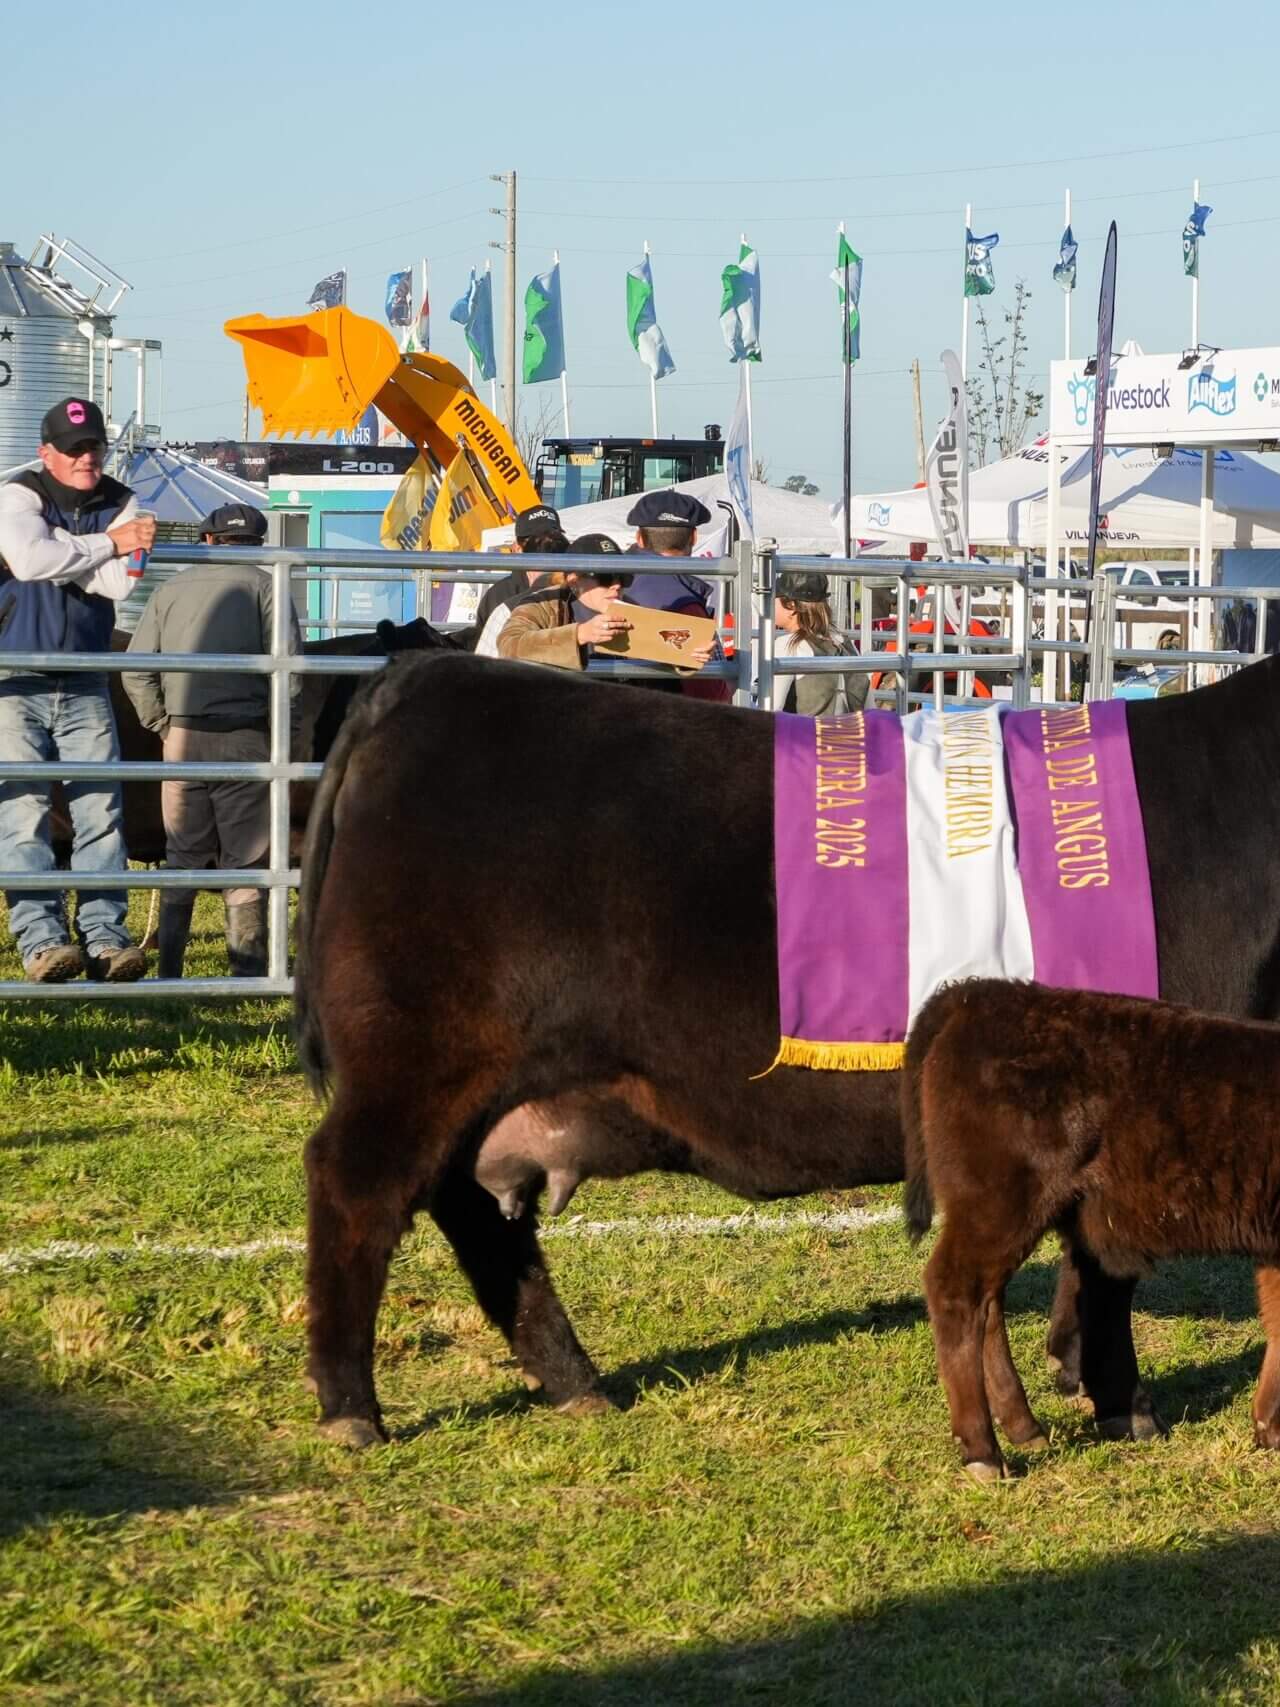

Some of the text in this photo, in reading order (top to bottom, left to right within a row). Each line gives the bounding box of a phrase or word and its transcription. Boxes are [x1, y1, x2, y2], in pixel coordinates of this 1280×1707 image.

[1104, 379, 1170, 409] ivestock
[454, 398, 521, 485] MICHIGAN
[322, 459, 395, 474] L200
[1065, 529, 1140, 541] VILLNUEVA
[1047, 755, 1098, 791] DE
[945, 764, 993, 859] HEMBRA
[815, 817, 867, 869] 2025
[1052, 799, 1110, 889] ANGUS
